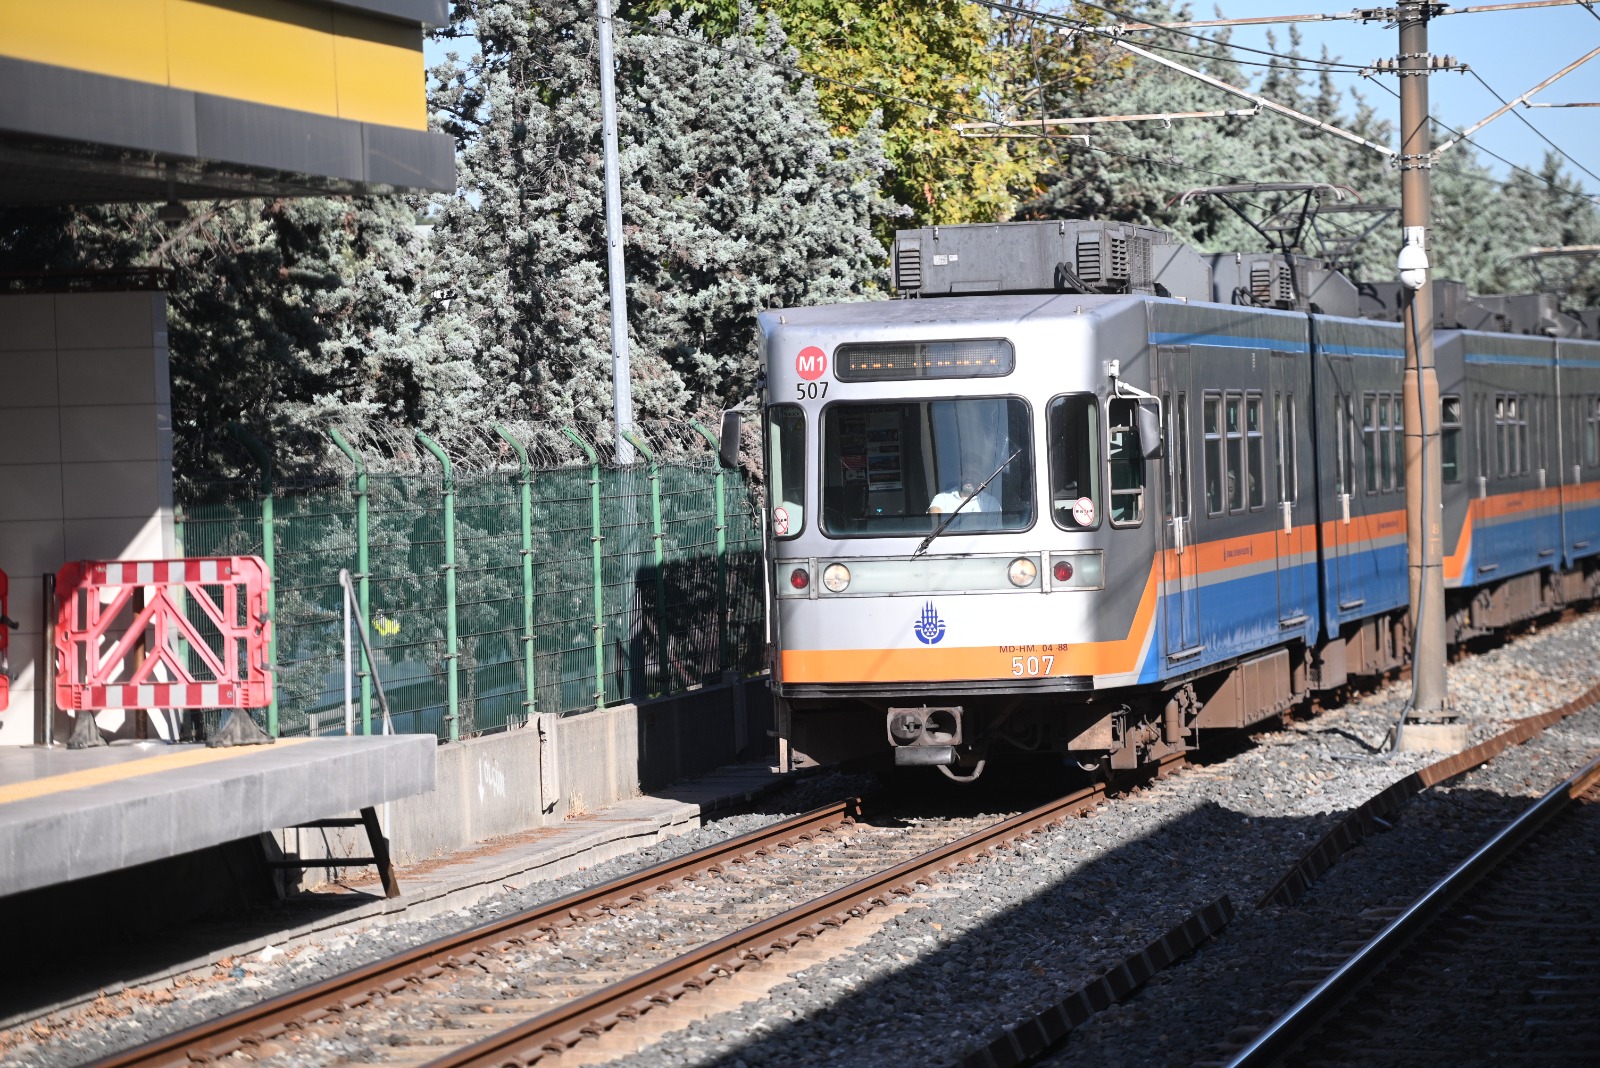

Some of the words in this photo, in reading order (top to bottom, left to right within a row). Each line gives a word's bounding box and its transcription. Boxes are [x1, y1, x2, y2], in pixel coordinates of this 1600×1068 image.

[799, 355, 824, 372] M1
[796, 381, 829, 401] 507
[1011, 654, 1055, 677] 507
